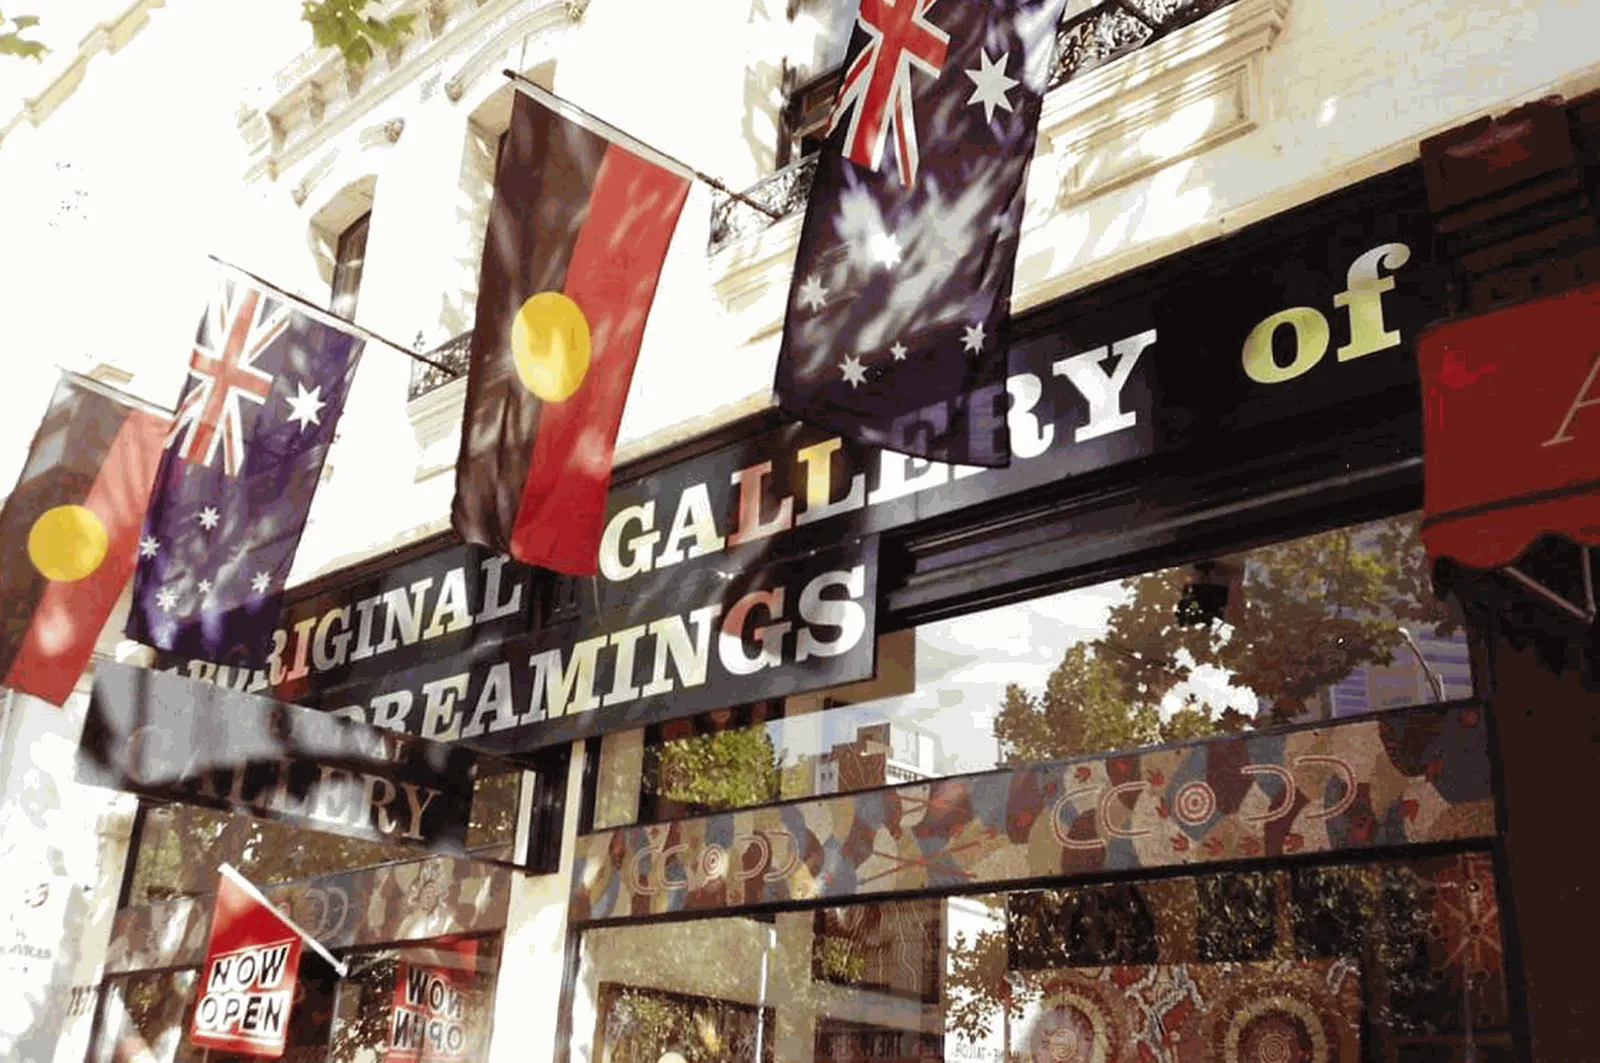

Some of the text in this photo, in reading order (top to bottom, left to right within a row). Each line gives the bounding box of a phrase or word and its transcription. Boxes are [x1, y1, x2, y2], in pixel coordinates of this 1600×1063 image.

[1241, 242, 1411, 384] of
[329, 564, 867, 743] REAMINGS
[211, 944, 287, 987] NOW
[199, 996, 284, 1034] OPEN
